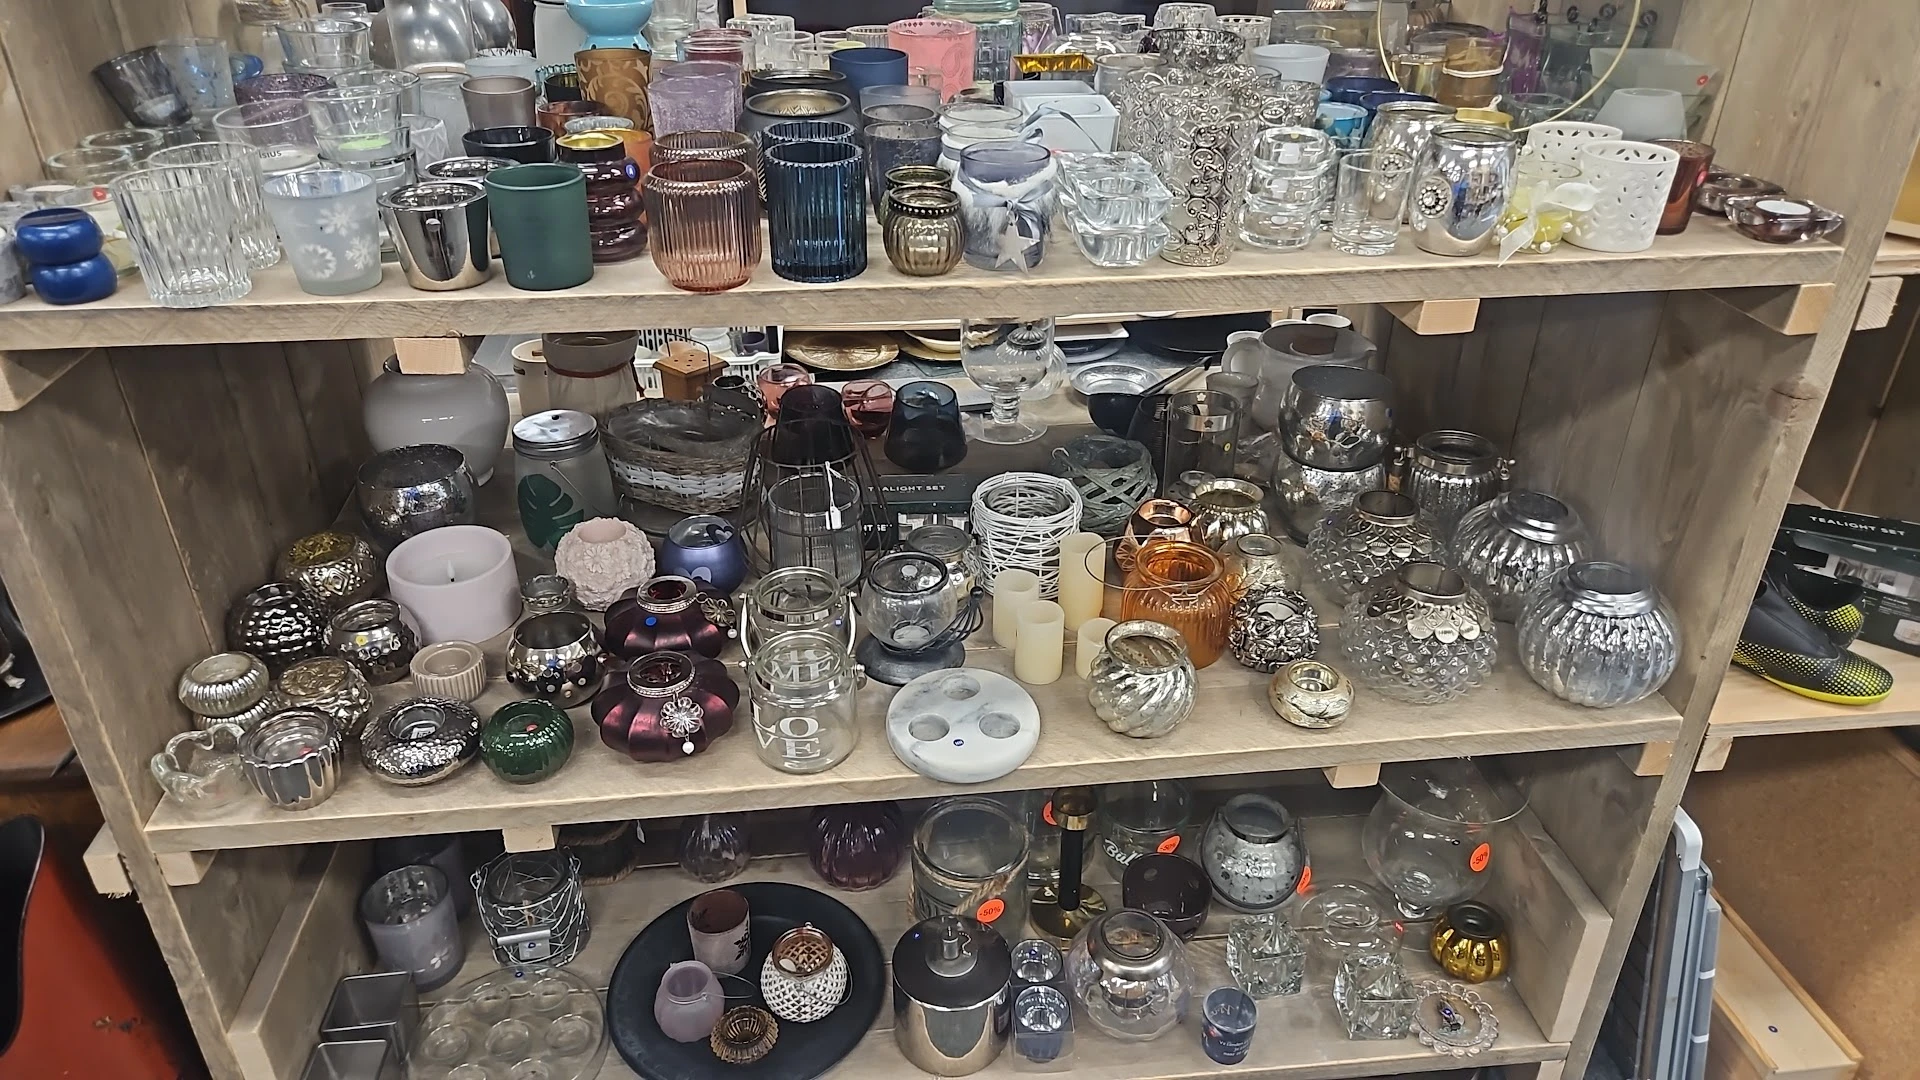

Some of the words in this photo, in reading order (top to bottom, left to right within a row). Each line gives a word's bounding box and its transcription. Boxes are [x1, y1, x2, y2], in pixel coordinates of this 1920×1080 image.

[1809, 515, 1877, 531] TEALIGHT
[1880, 527, 1906, 536] SET
[979, 905, 1001, 917] -50%
